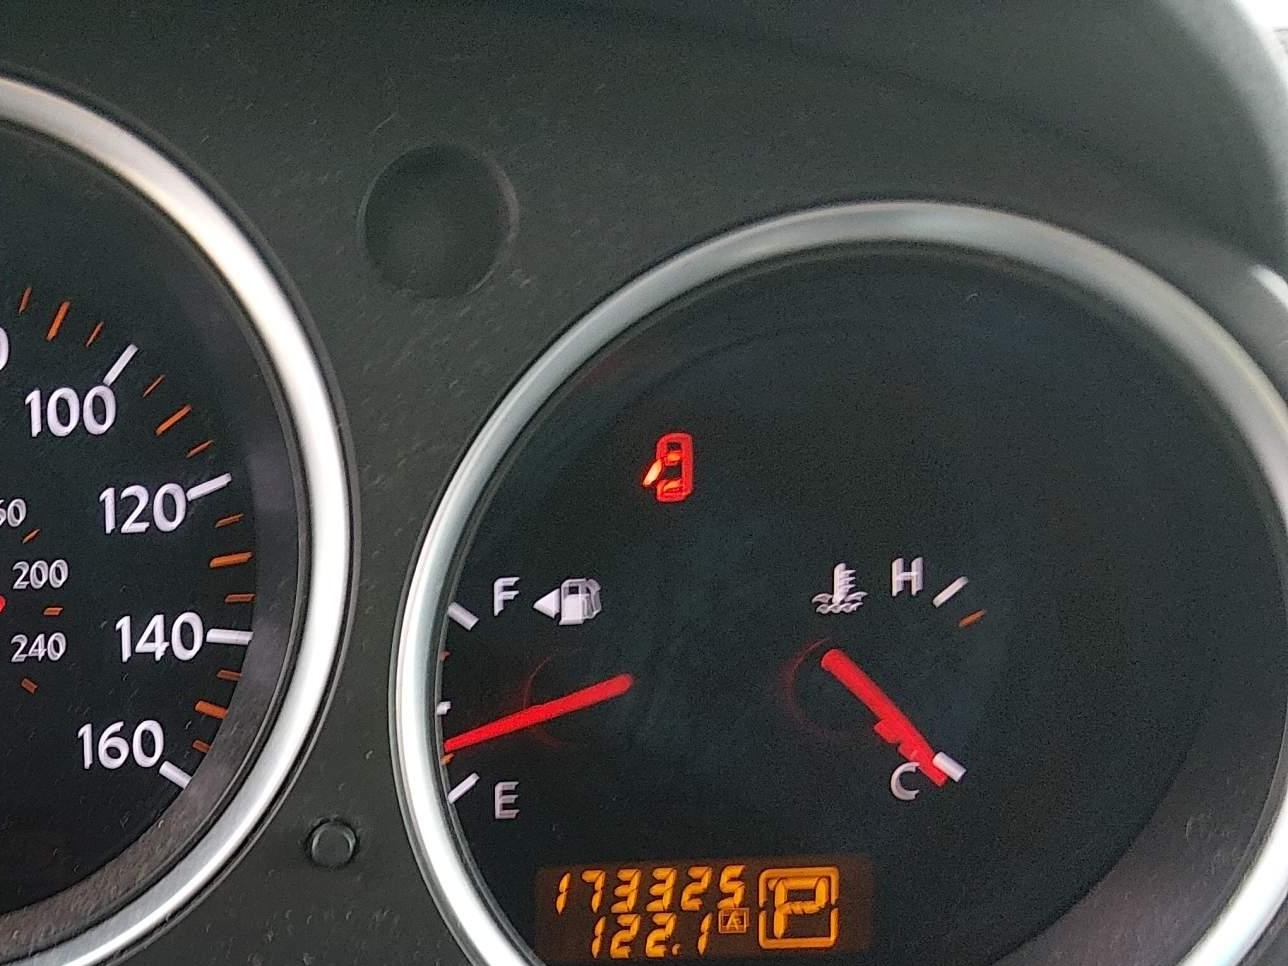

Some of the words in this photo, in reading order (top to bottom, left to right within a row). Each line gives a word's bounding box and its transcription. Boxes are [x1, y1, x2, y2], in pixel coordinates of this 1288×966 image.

[25, 385, 116, 439] 100
[99, 481, 188, 535] 120
[12, 559, 68, 590] 200
[492, 575, 520, 616] F
[891, 557, 924, 596] H
[10, 632, 66, 664] 240
[116, 610, 204, 663] 140
[76, 719, 166, 771] 160
[494, 780, 519, 821] E
[889, 761, 922, 802] C
[554, 865, 746, 916] 173325
[773, 877, 829, 940] P
[591, 913, 711, 959] 122.1
